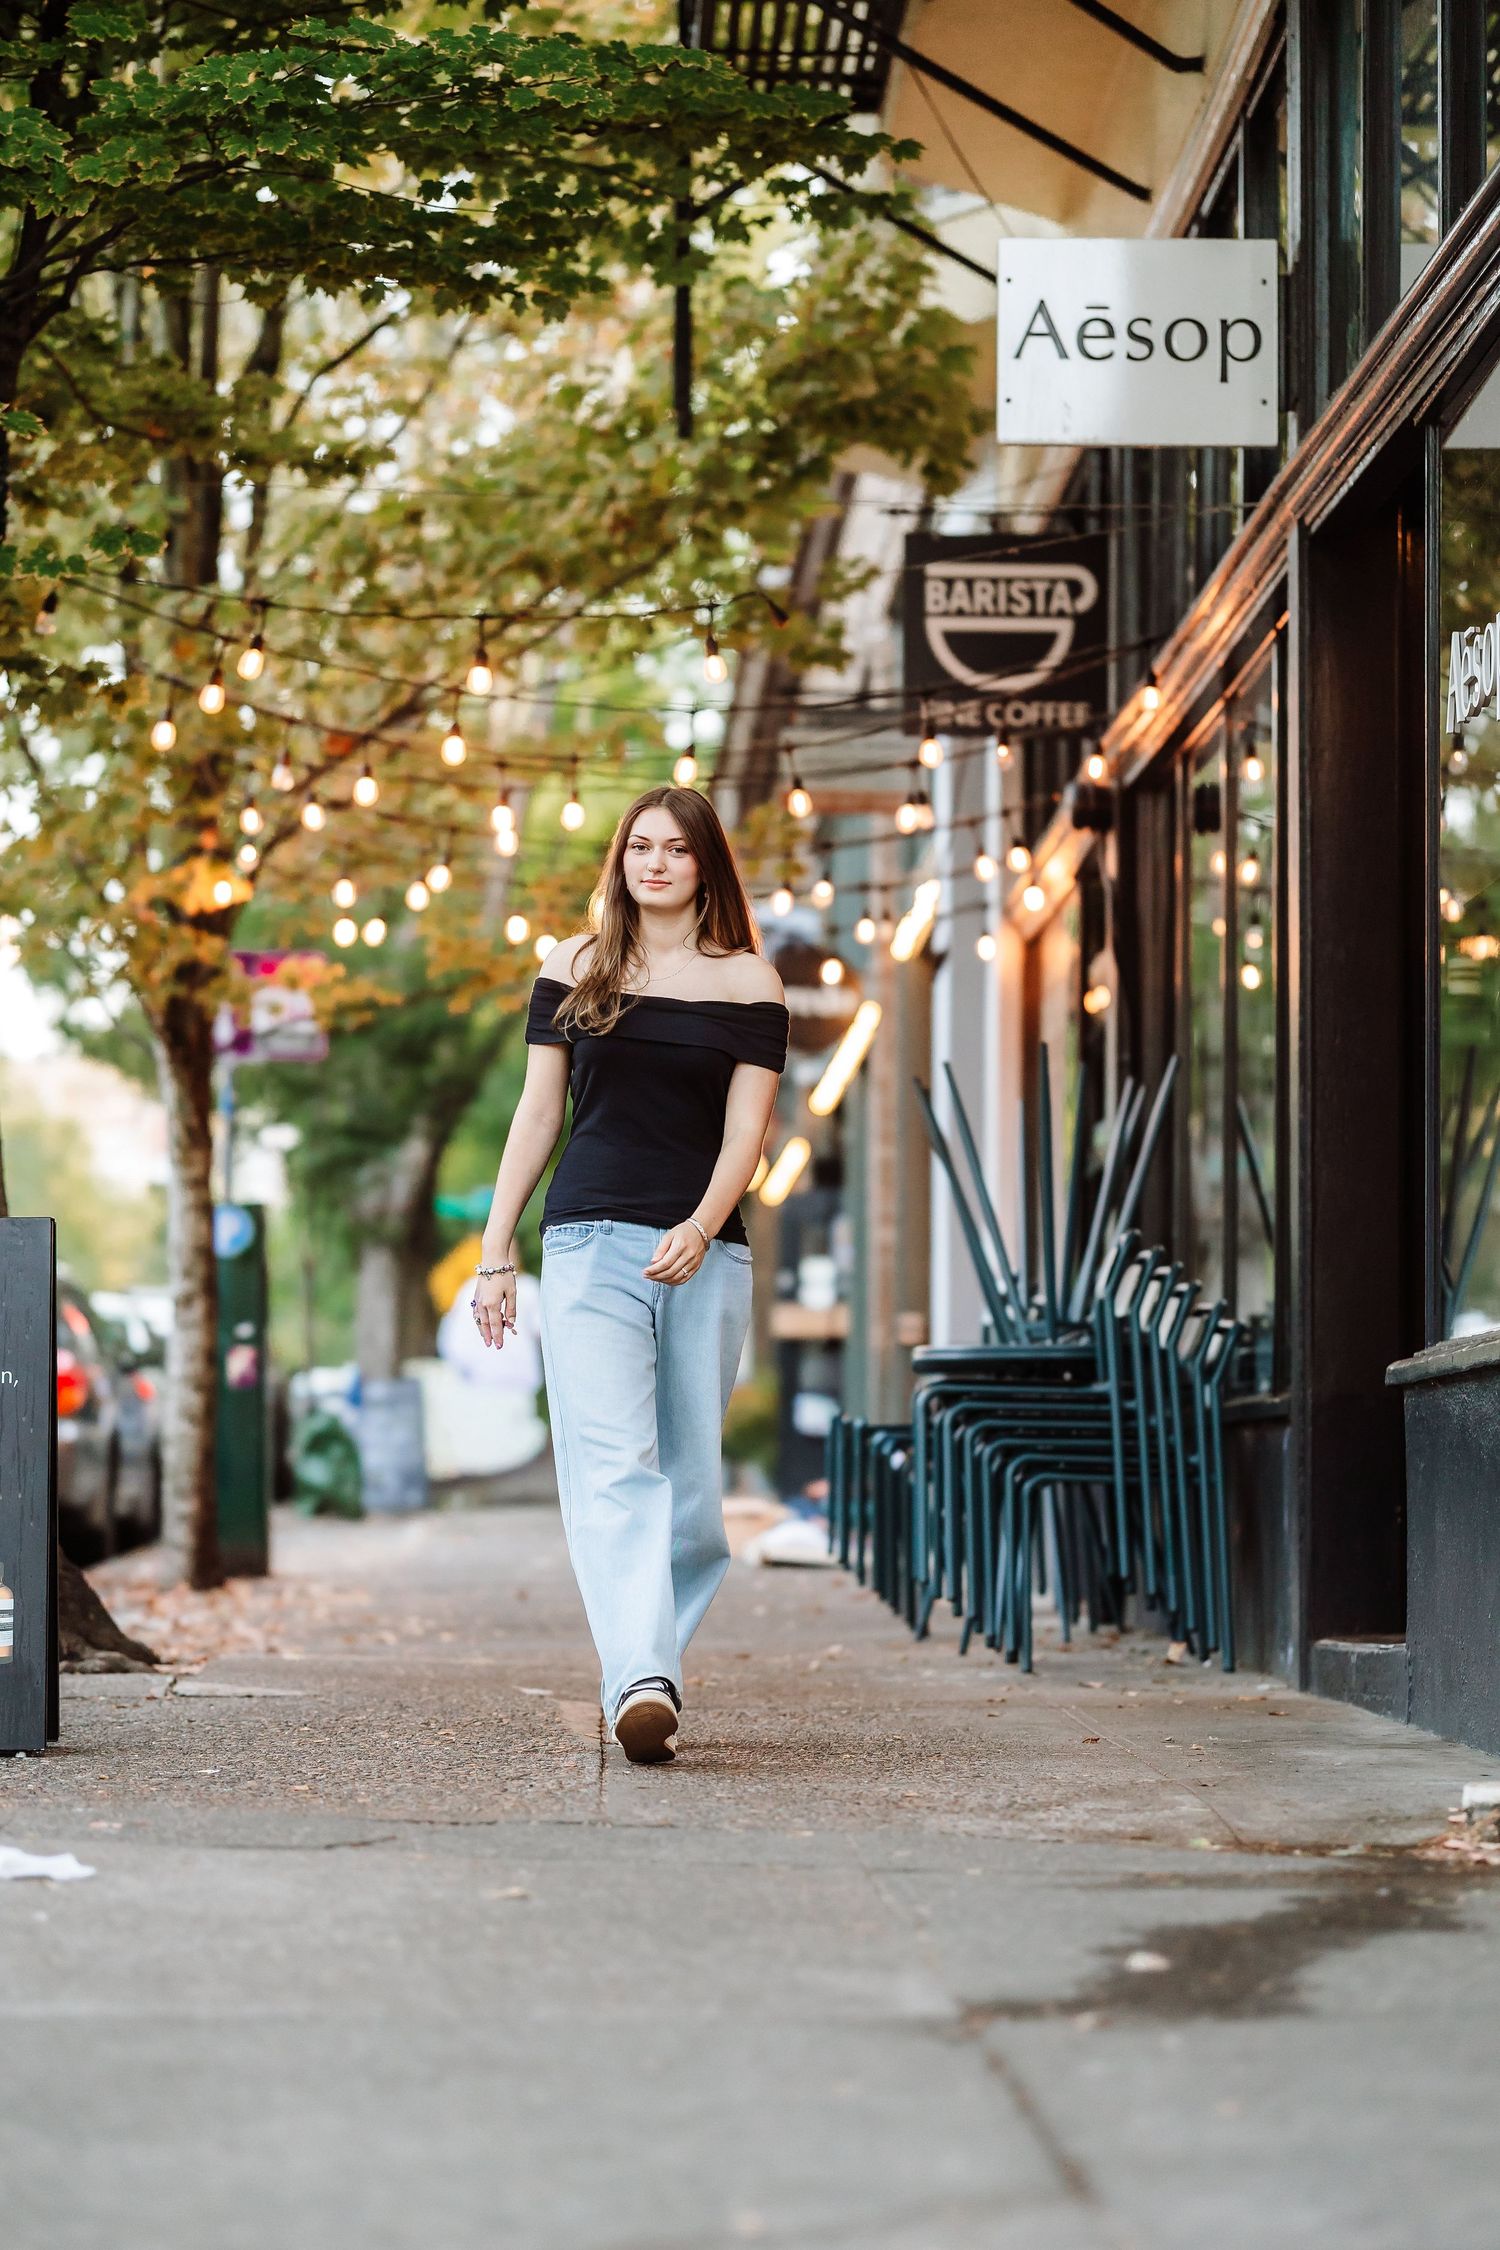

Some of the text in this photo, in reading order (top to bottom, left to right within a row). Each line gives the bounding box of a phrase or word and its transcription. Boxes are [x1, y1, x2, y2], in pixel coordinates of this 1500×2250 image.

[1013, 299, 1262, 384] Aēsop
[925, 578, 1074, 615] BARISTA
[1446, 611, 1500, 734] Aēso
